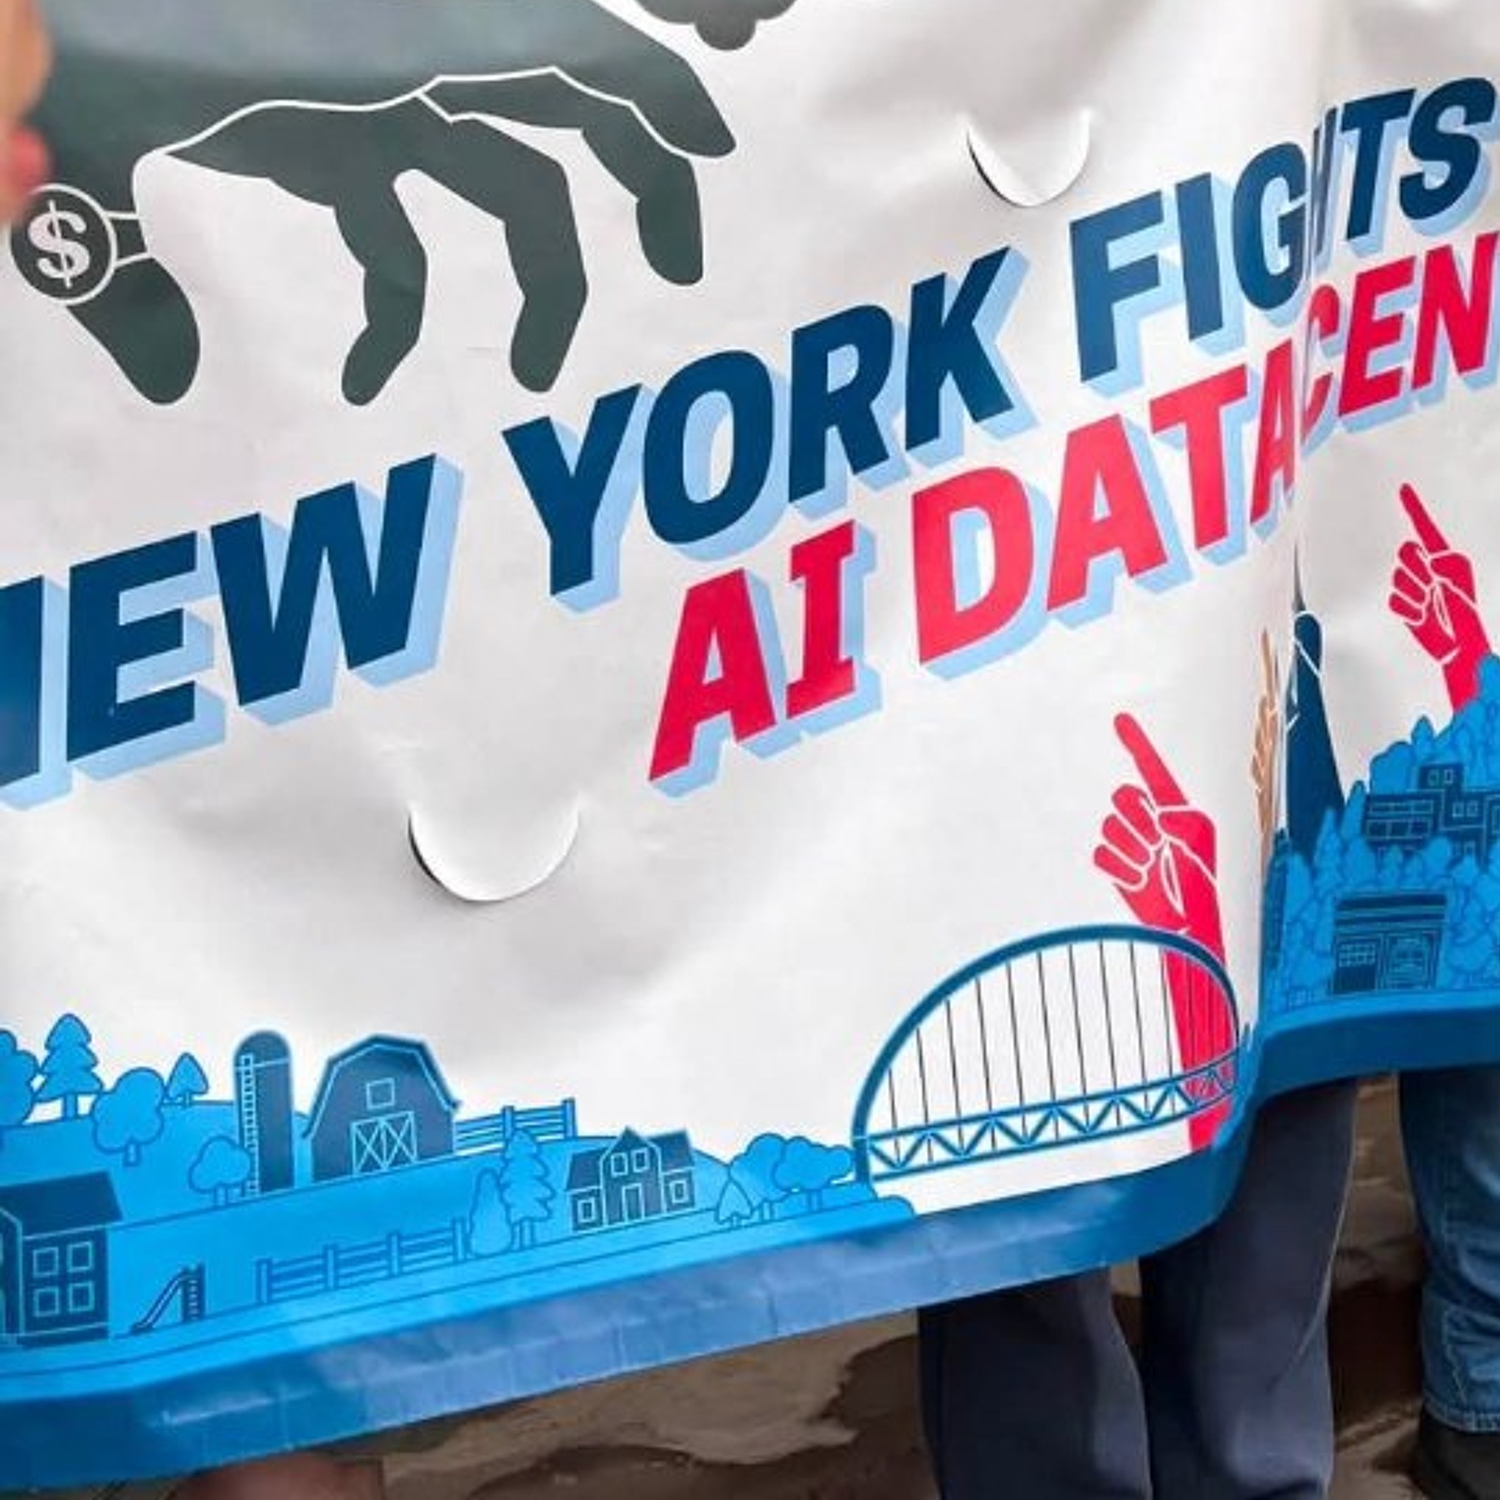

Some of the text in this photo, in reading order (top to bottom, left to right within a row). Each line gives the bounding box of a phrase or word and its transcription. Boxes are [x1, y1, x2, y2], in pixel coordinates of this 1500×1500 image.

[502, 245, 1028, 613] YORK
[648, 518, 884, 798] AI
[912, 338, 1298, 666] DATA
